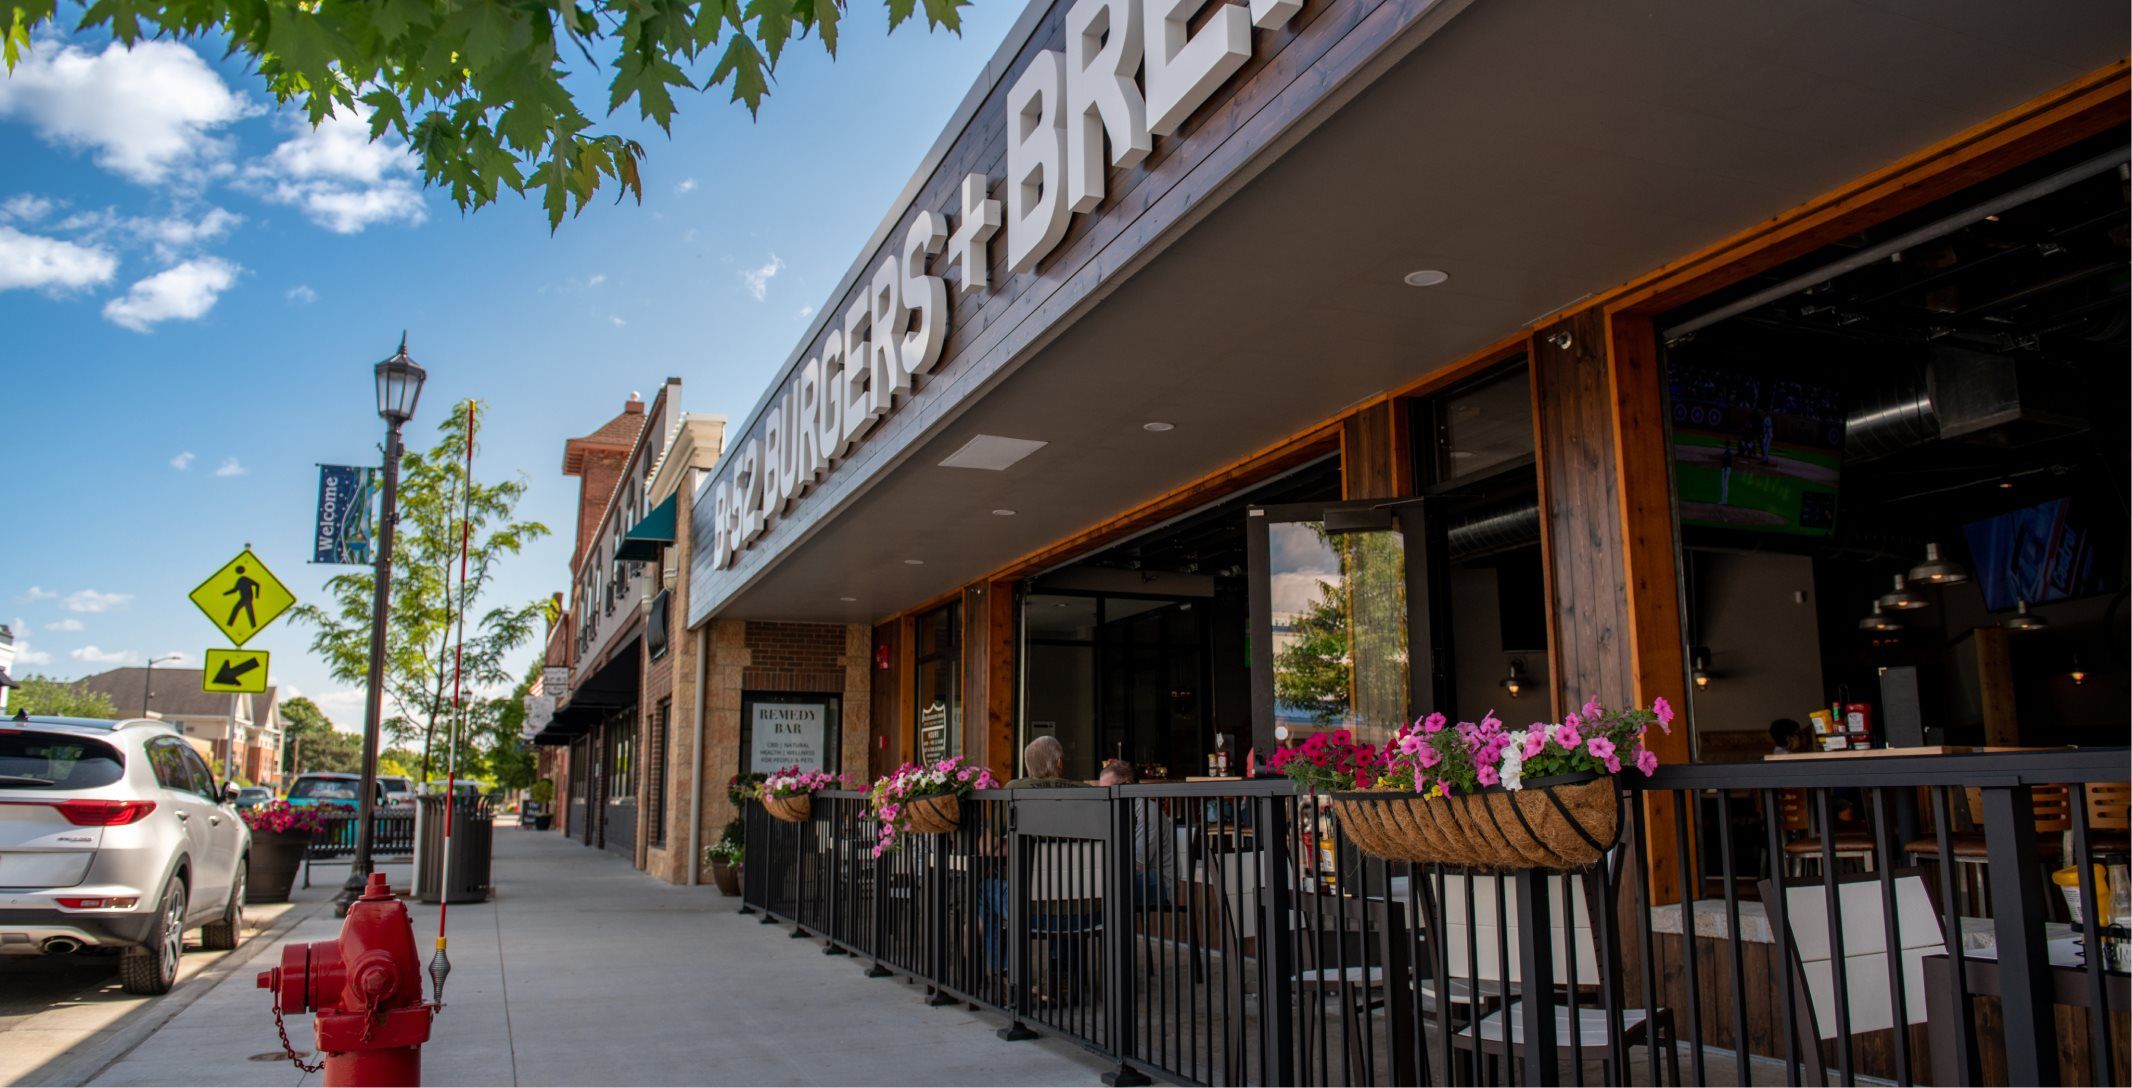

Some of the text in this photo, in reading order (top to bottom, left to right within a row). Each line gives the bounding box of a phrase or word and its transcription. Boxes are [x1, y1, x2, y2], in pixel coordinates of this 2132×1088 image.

[762, 209, 948, 521] BURGERS
[1007, 0, 1302, 273] BRE
[318, 476, 339, 551] Welcome
[760, 708, 816, 721] REMEDY
[775, 723, 802, 734] BAR
